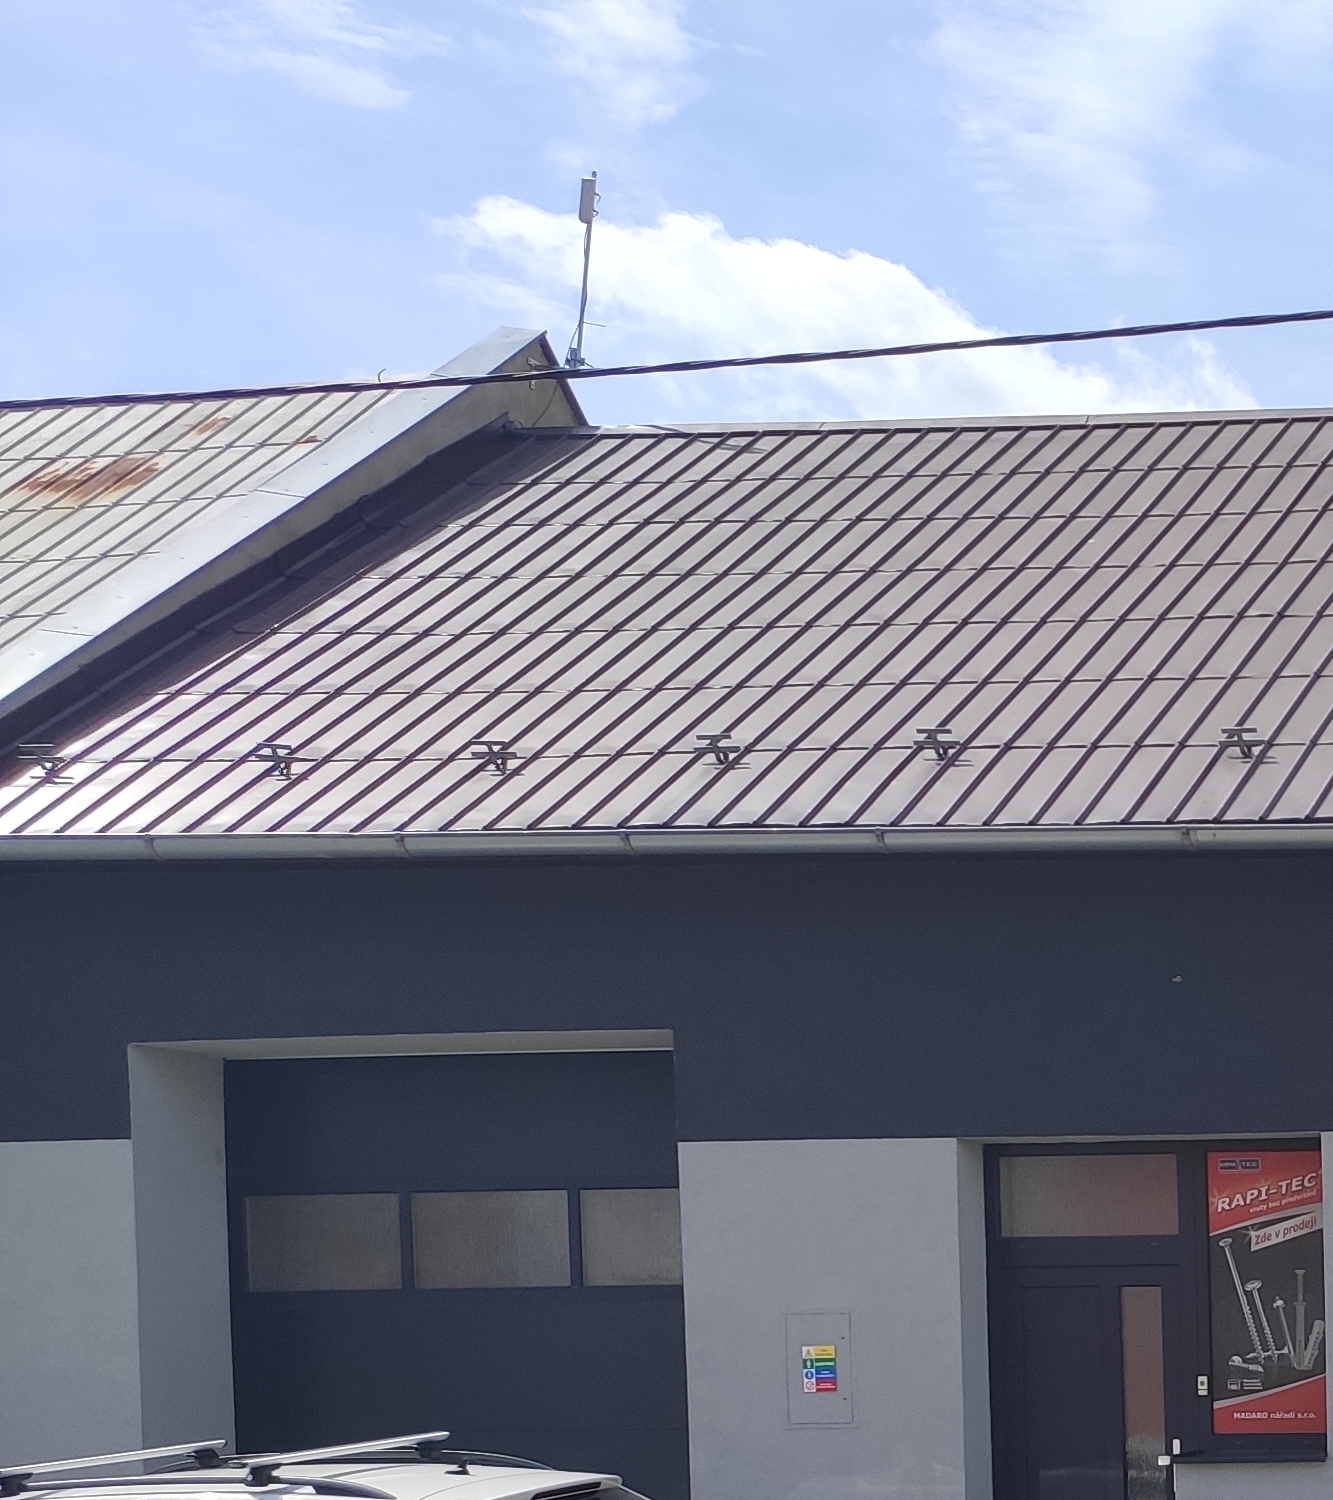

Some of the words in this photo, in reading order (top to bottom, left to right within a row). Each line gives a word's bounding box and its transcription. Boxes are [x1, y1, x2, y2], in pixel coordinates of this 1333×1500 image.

[1217, 1173, 1317, 1212] RAPI-TEC
[1254, 1231, 1273, 1246] Zde
[1275, 1229, 1281, 1239] v
[1283, 1216, 1317, 1239] prodeji
